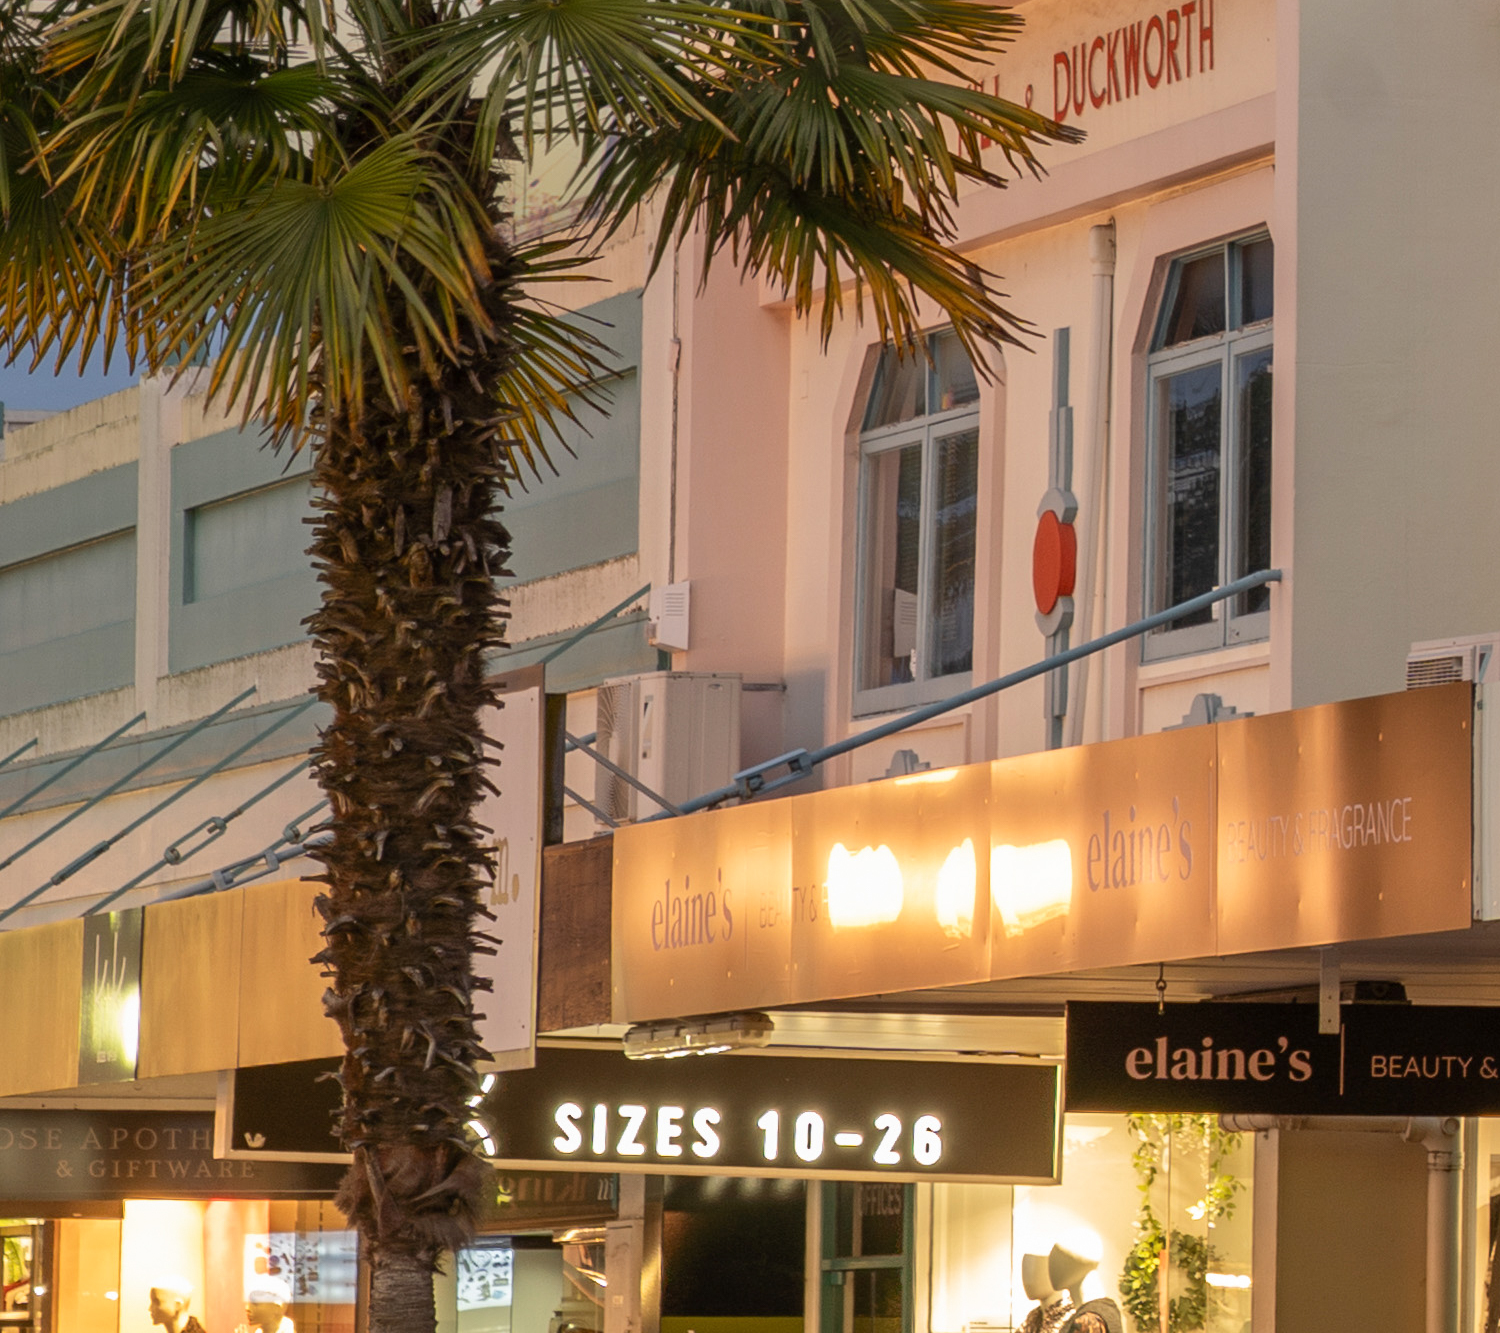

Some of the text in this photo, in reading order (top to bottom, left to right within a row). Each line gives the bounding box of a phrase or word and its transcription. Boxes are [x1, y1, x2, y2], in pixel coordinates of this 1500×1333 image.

[1086, 795, 1193, 892] elaine's
[1227, 815, 1288, 864] BEAUTY
[1309, 797, 1412, 852] FRAGRANCE
[652, 867, 734, 952] elaine's
[1125, 1036, 1312, 1083] elaine's
[1371, 1054, 1473, 1081] BEAUTY
[1479, 1057, 1499, 1081] &
[553, 1102, 721, 1158] SIZES
[757, 1109, 943, 1166] 10-26
[56, 1160, 256, 1178] & GIFTWARE
